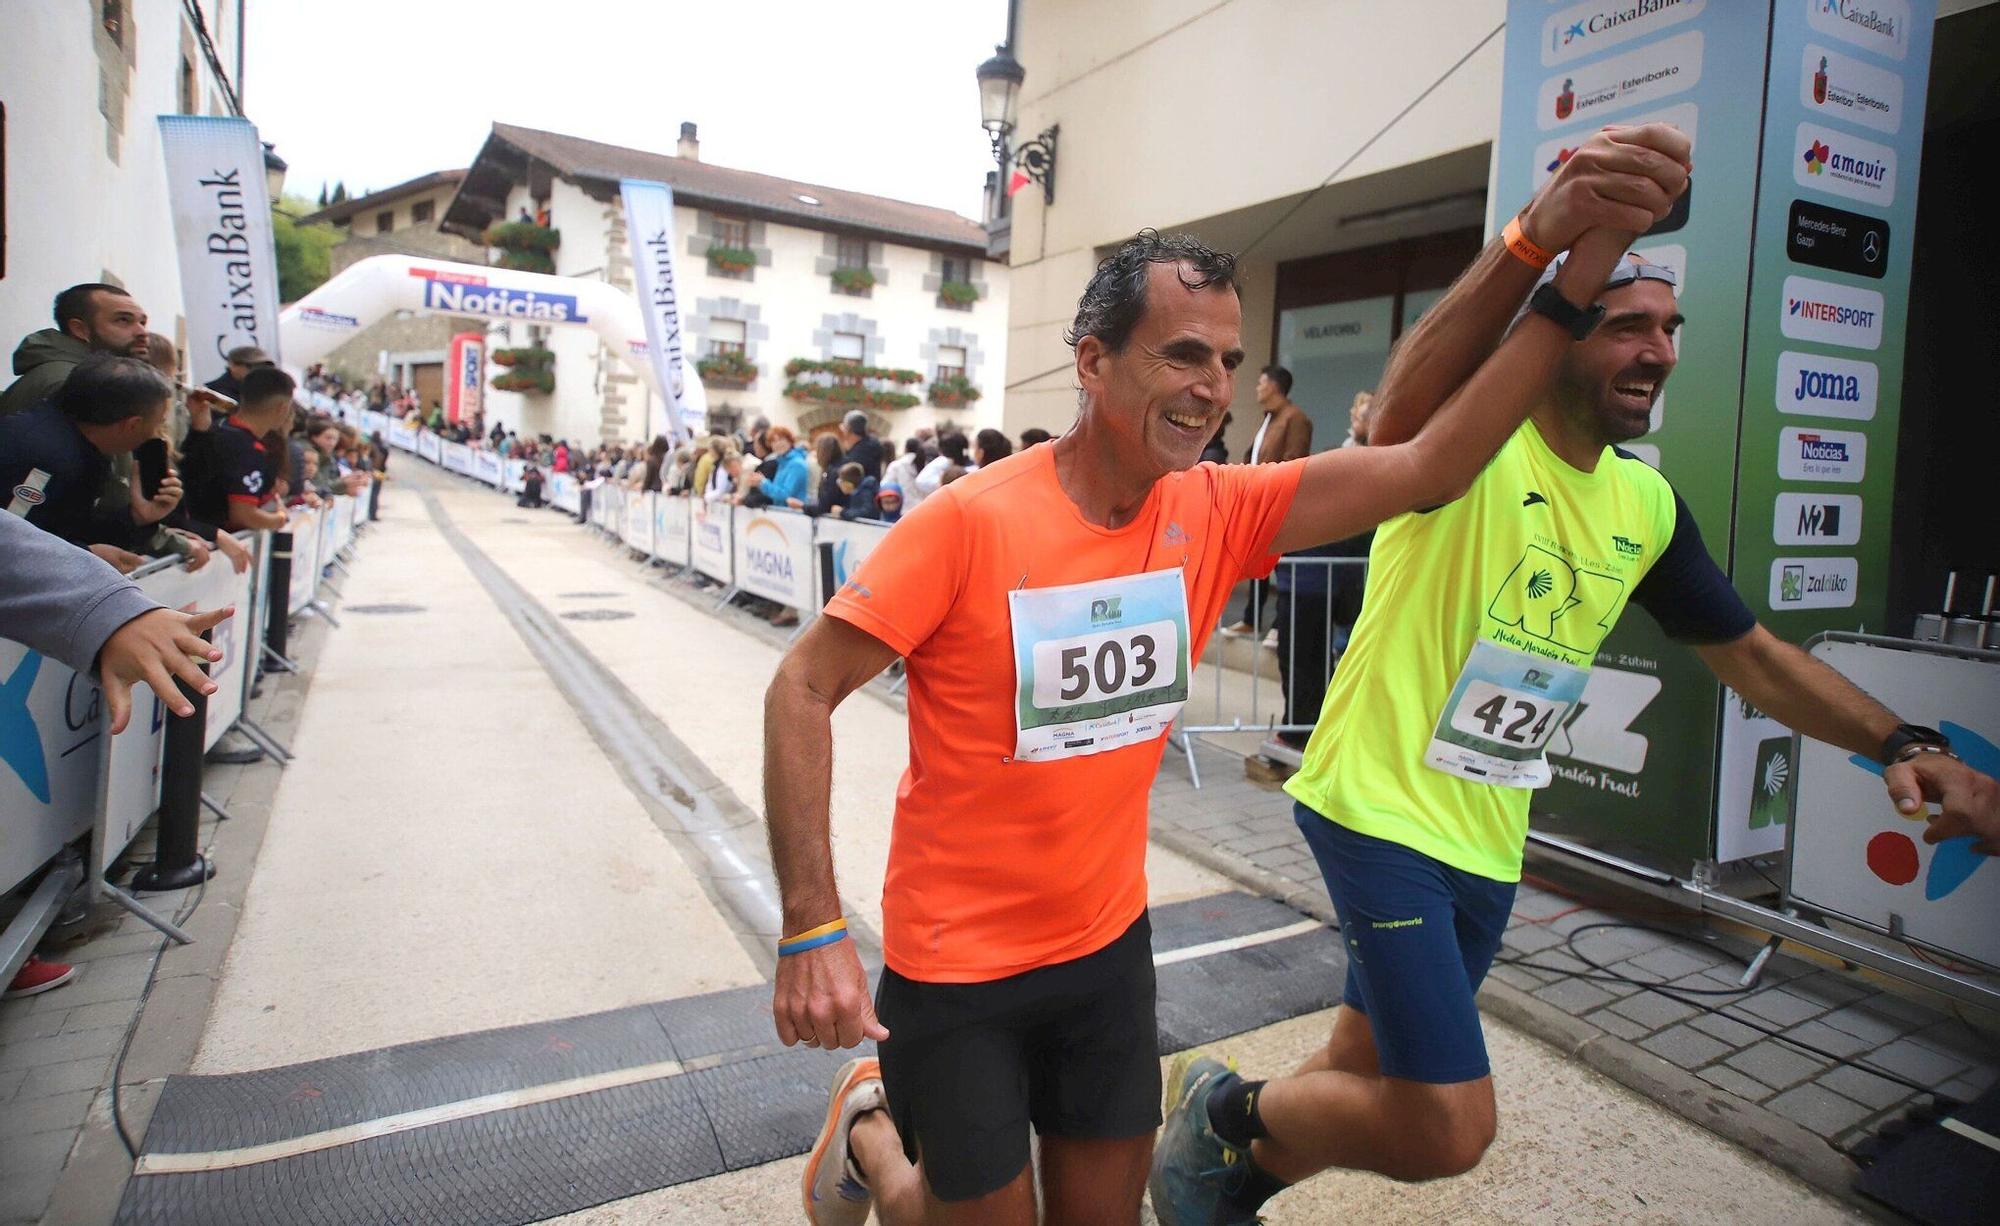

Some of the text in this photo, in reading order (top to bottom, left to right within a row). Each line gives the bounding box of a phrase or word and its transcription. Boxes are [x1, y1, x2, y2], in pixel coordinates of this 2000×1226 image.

[1588, 0, 1680, 33] CaixaBan
[1840, 0, 1895, 37] CaixaBank
[1621, 65, 1680, 91] Esteribarko
[1831, 153, 1886, 182] amavir
[1796, 233, 1816, 248] Gazpi
[1798, 216, 1847, 237] Mercedes-Benz
[199, 168, 259, 362] CaixaBank
[430, 280, 568, 322] Noticias
[648, 230, 685, 400] CaixaBank
[1801, 301, 1875, 328] INTERSPORT
[1803, 444, 1844, 461] Noticias
[746, 546, 794, 582] MAGNA
[1060, 634, 1157, 701] 503
[1473, 694, 1555, 744] 424
[1550, 763, 1641, 799] aratón Trail
